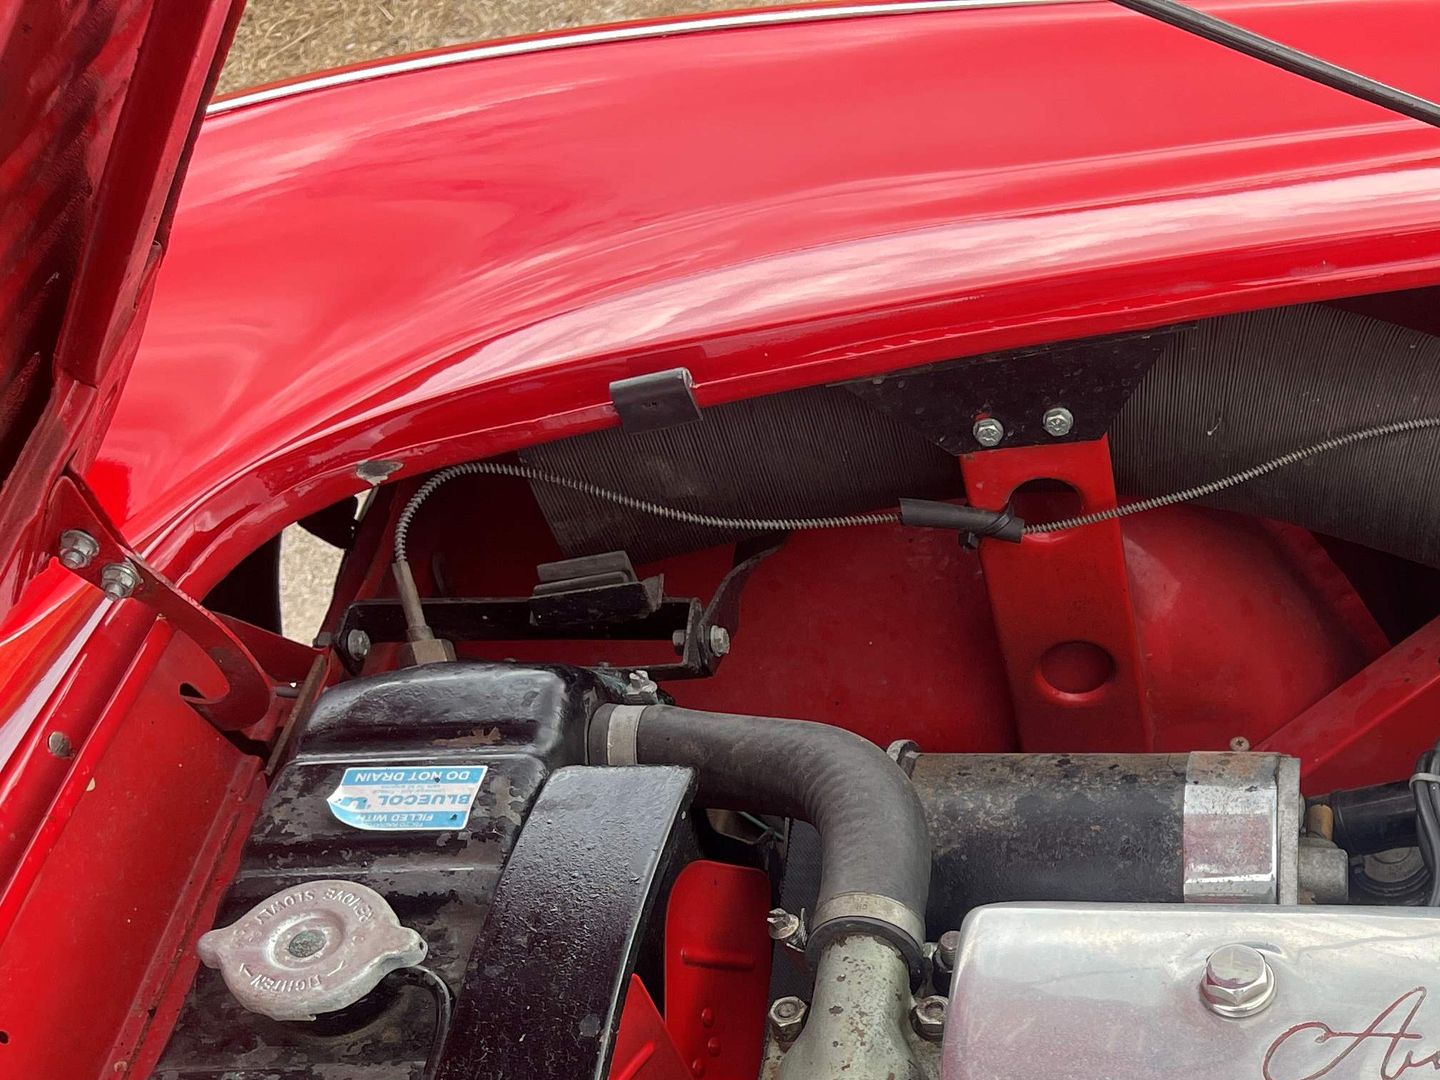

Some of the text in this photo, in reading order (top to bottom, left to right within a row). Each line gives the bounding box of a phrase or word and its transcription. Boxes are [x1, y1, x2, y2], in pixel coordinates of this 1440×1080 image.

[354, 770, 471, 783] DO NOT DRAIN
[378, 794, 472, 806] BLUECOL
[355, 813, 434, 822] FILLED WITH
[256, 887, 374, 926] REMOVE SLOWLY
[250, 973, 323, 993] TIGHTEN
